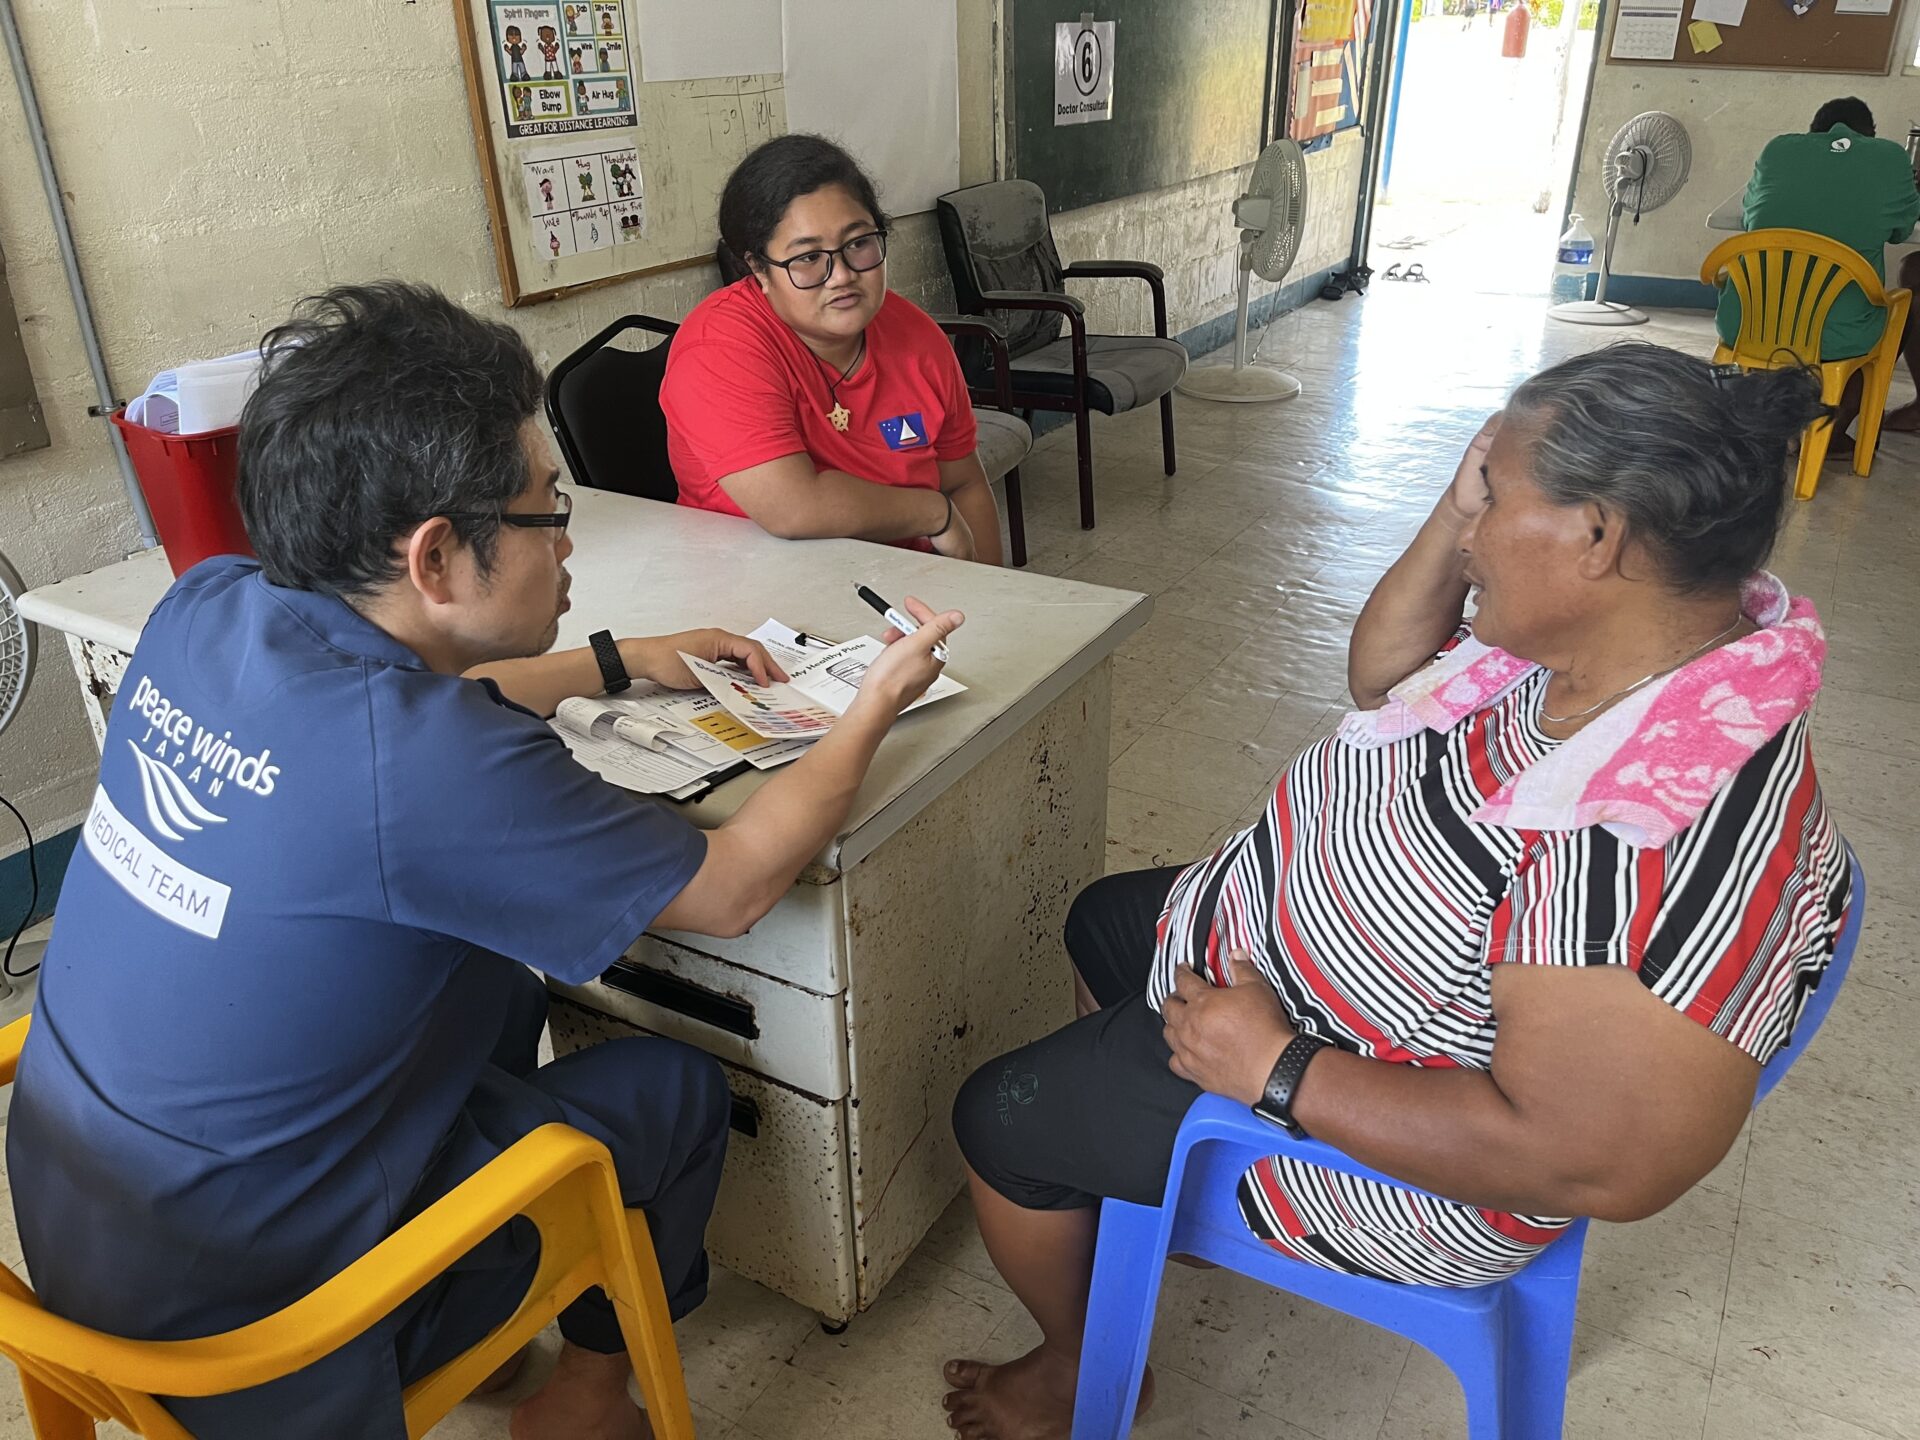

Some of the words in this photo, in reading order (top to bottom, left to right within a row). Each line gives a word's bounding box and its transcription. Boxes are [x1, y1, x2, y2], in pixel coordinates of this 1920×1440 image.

[576, 4, 588, 13] Dab
[594, 3, 605, 12] Silly
[605, 3, 617, 11] Face
[503, 8, 522, 20] Spirit
[524, 8, 550, 20] Fingers
[606, 42, 621, 51] Smile
[1082, 41, 1093, 83] 6
[539, 89, 560, 99] Elbow
[592, 90, 602, 99] Air
[603, 90, 614, 100] Hug
[541, 101, 562, 113] Bump
[1057, 103, 1079, 115] Doctor
[519, 122, 542, 136] GREAT
[543, 121, 558, 133] FOR
[559, 118, 593, 131] DISTANCE
[594, 115, 629, 129] LEARNING
[575, 159, 591, 170] Hug
[790, 668, 807, 679] My
[806, 651, 843, 671] Healthy
[841, 643, 866, 654] Plate
[129, 675, 193, 746] peace
[190, 726, 281, 796] winds
[142, 727, 224, 798] JAPAN
[88, 802, 140, 879] MEDICAL
[150, 864, 211, 918] TEAM
